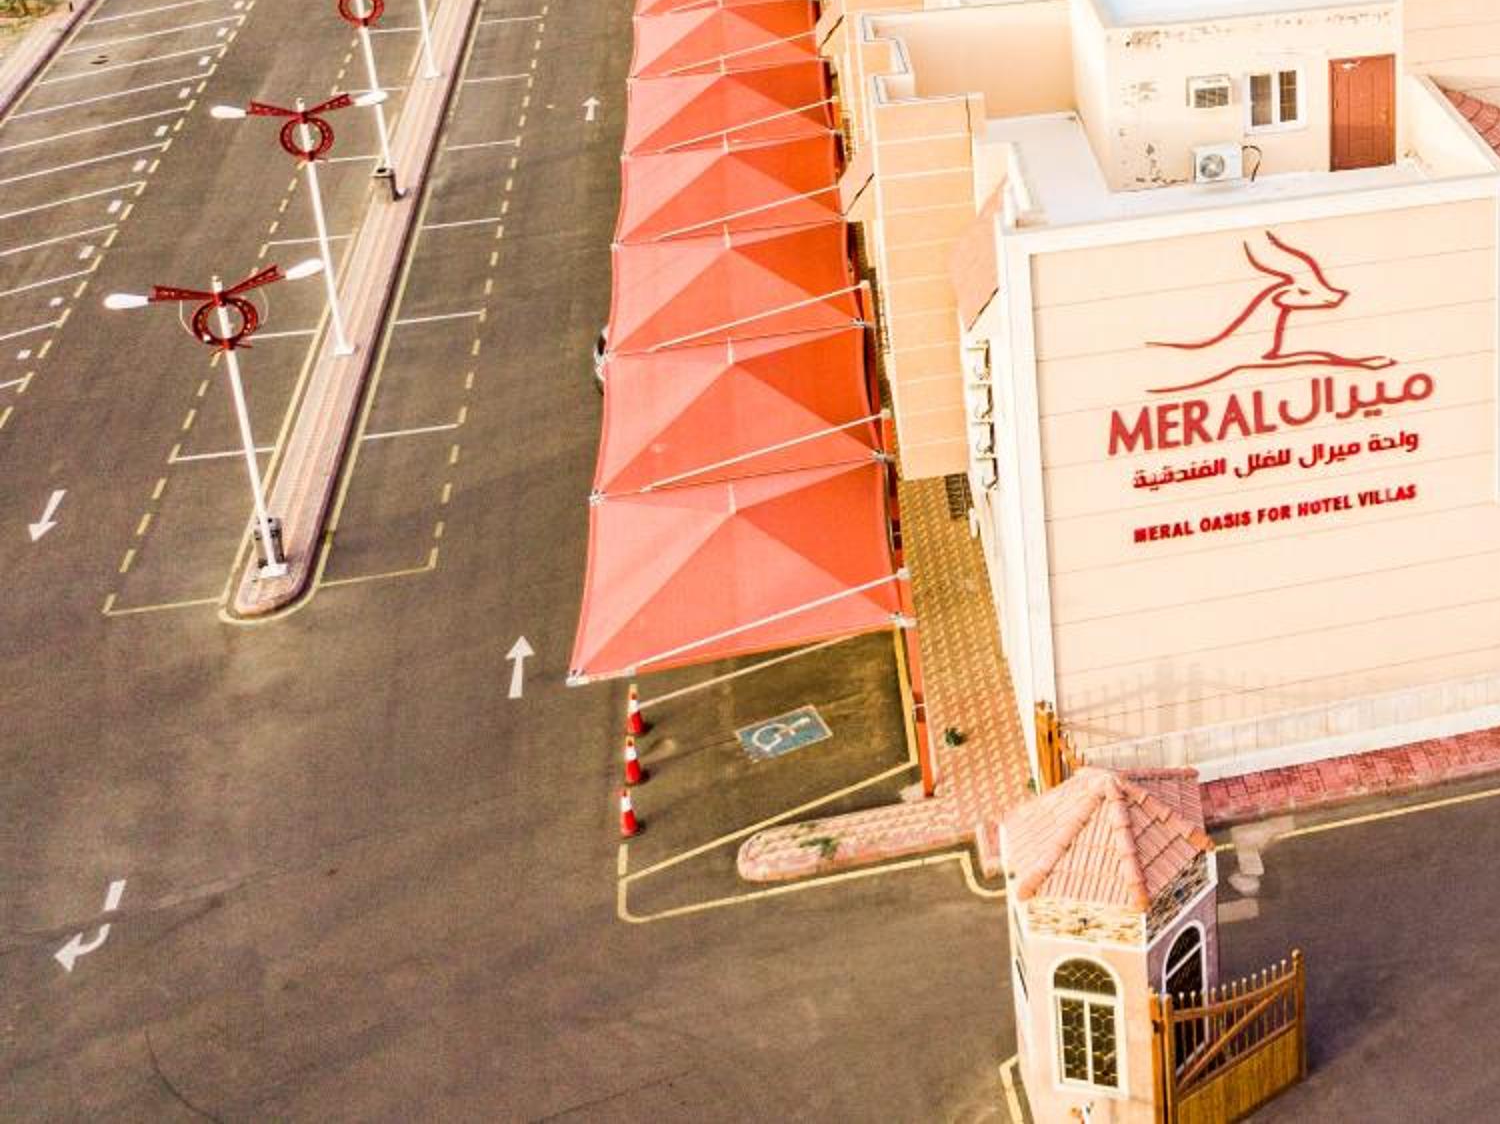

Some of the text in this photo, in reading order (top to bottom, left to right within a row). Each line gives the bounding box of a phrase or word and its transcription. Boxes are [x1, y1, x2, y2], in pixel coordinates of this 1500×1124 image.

[1278, 372, 1435, 428] ميرال
[1107, 389, 1278, 457] MERAL
[1367, 430, 1420, 453] واحة
[1132, 457, 1227, 492] الفندقية
[1298, 441, 1362, 469] ميرال
[1133, 483, 1418, 544] MERAL OASIS FOR HOTEL VILLAS
